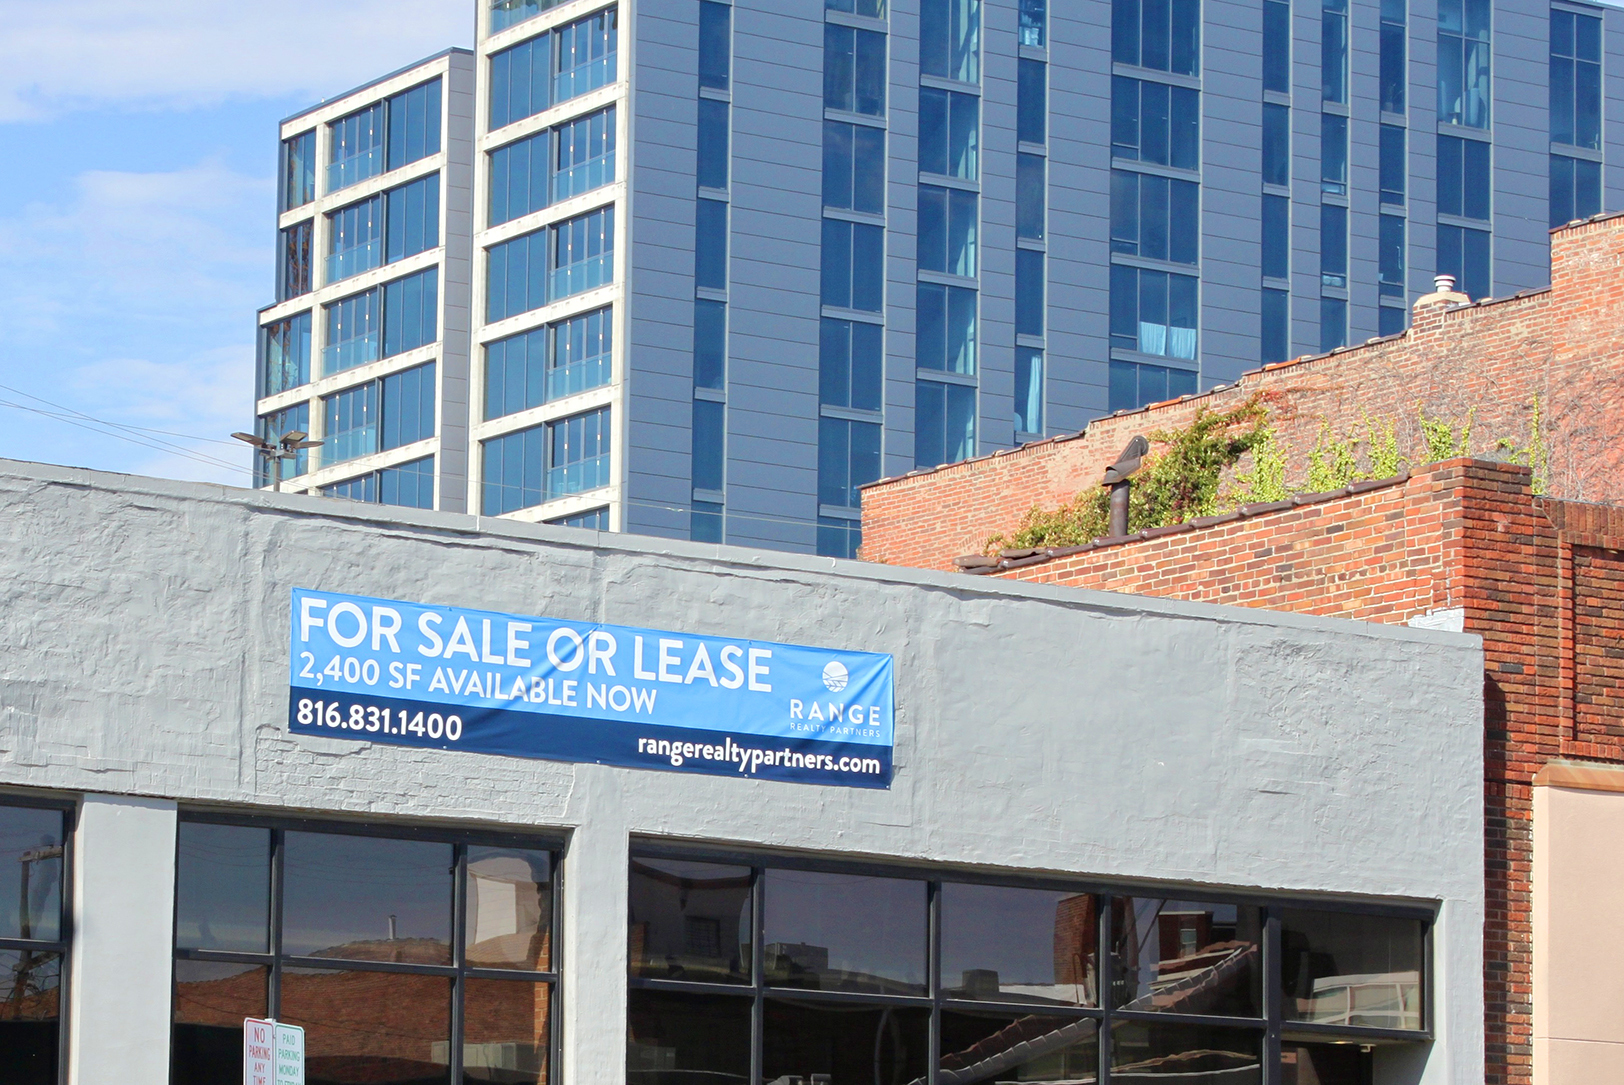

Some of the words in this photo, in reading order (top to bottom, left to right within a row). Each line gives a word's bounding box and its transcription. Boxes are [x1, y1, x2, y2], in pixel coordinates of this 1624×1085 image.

[300, 597, 402, 653] FOR
[417, 611, 533, 667] SALE
[546, 627, 618, 676] OR
[634, 635, 773, 693] LEASE
[299, 651, 380, 686] 2,400
[389, 662, 422, 690] SF
[428, 666, 578, 707] AVAILABLE
[586, 683, 657, 715] NOW
[296, 698, 463, 741] 816.831.1400
[789, 698, 881, 726] RANGE
[789, 722, 827, 733] REALTY
[829, 725, 881, 738] PARTNERS
[638, 736, 881, 775] rangerealtypartners.com
[254, 1027, 265, 1043] NO
[283, 1034, 295, 1045] PAID
[249, 1045, 270, 1061] PARKING
[279, 1049, 299, 1062] PARKING
[254, 1062, 265, 1073] ANY
[279, 1064, 299, 1076] MONDAY
